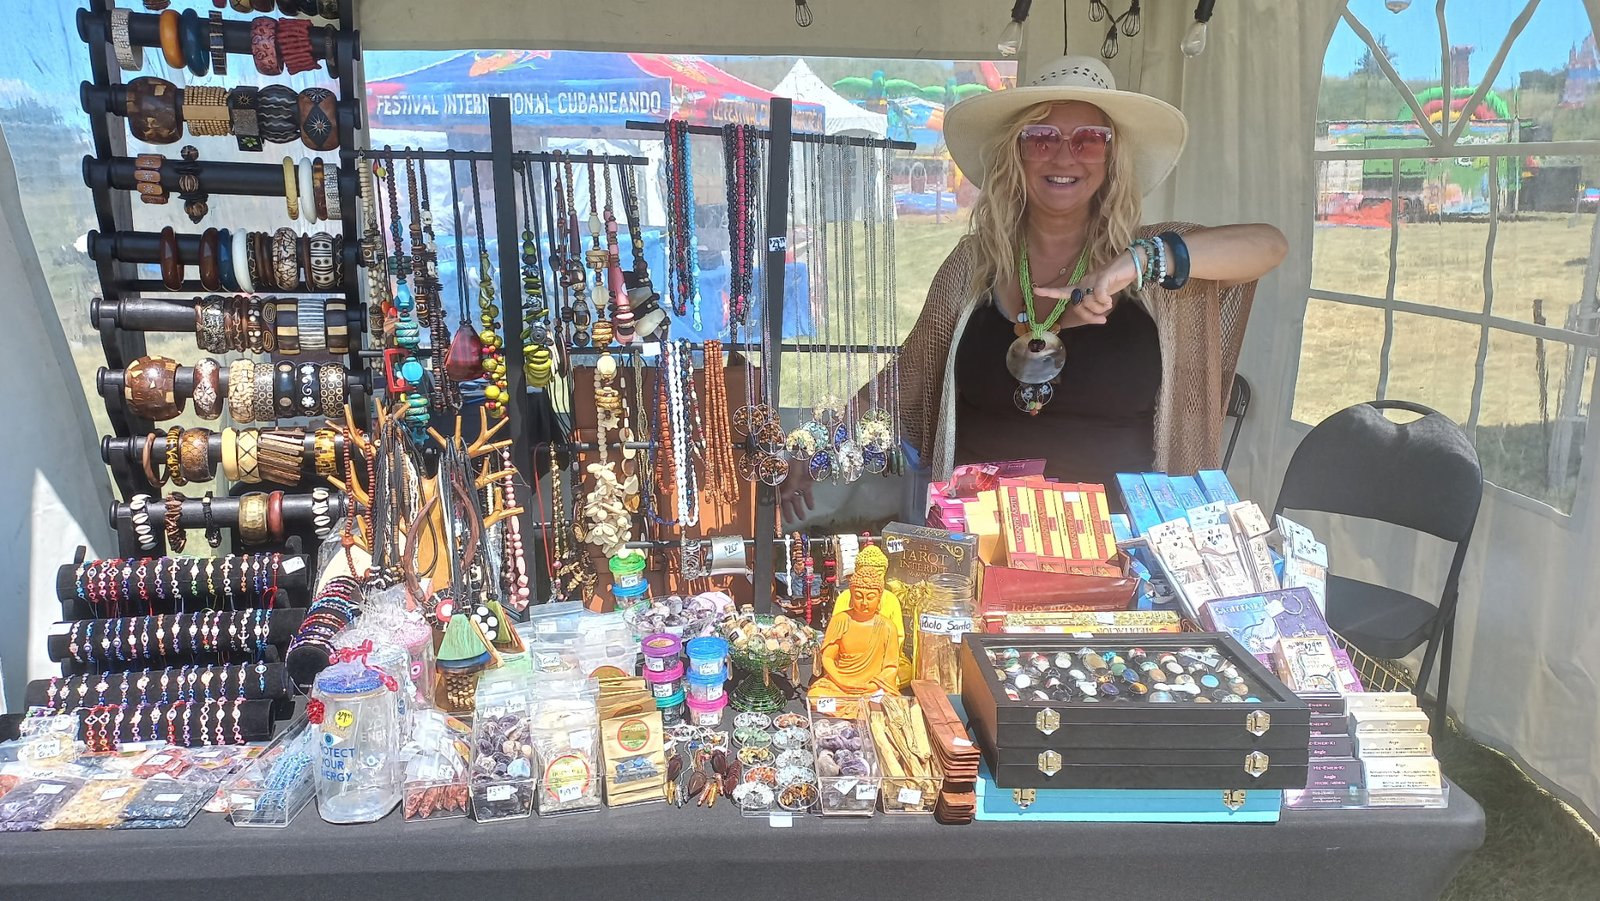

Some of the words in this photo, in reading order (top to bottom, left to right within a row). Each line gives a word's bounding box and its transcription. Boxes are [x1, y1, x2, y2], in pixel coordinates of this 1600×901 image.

[375, 93, 439, 115] FESTIVAL
[443, 92, 553, 115] INTERNIONAL
[557, 91, 662, 115] CUBANEANDO
[902, 548, 949, 566] TAROT
[899, 560, 949, 574] INTERDIT
[946, 619, 972, 632] Santo
[320, 742, 356, 758] OTECT
[322, 758, 345, 770] OUR
